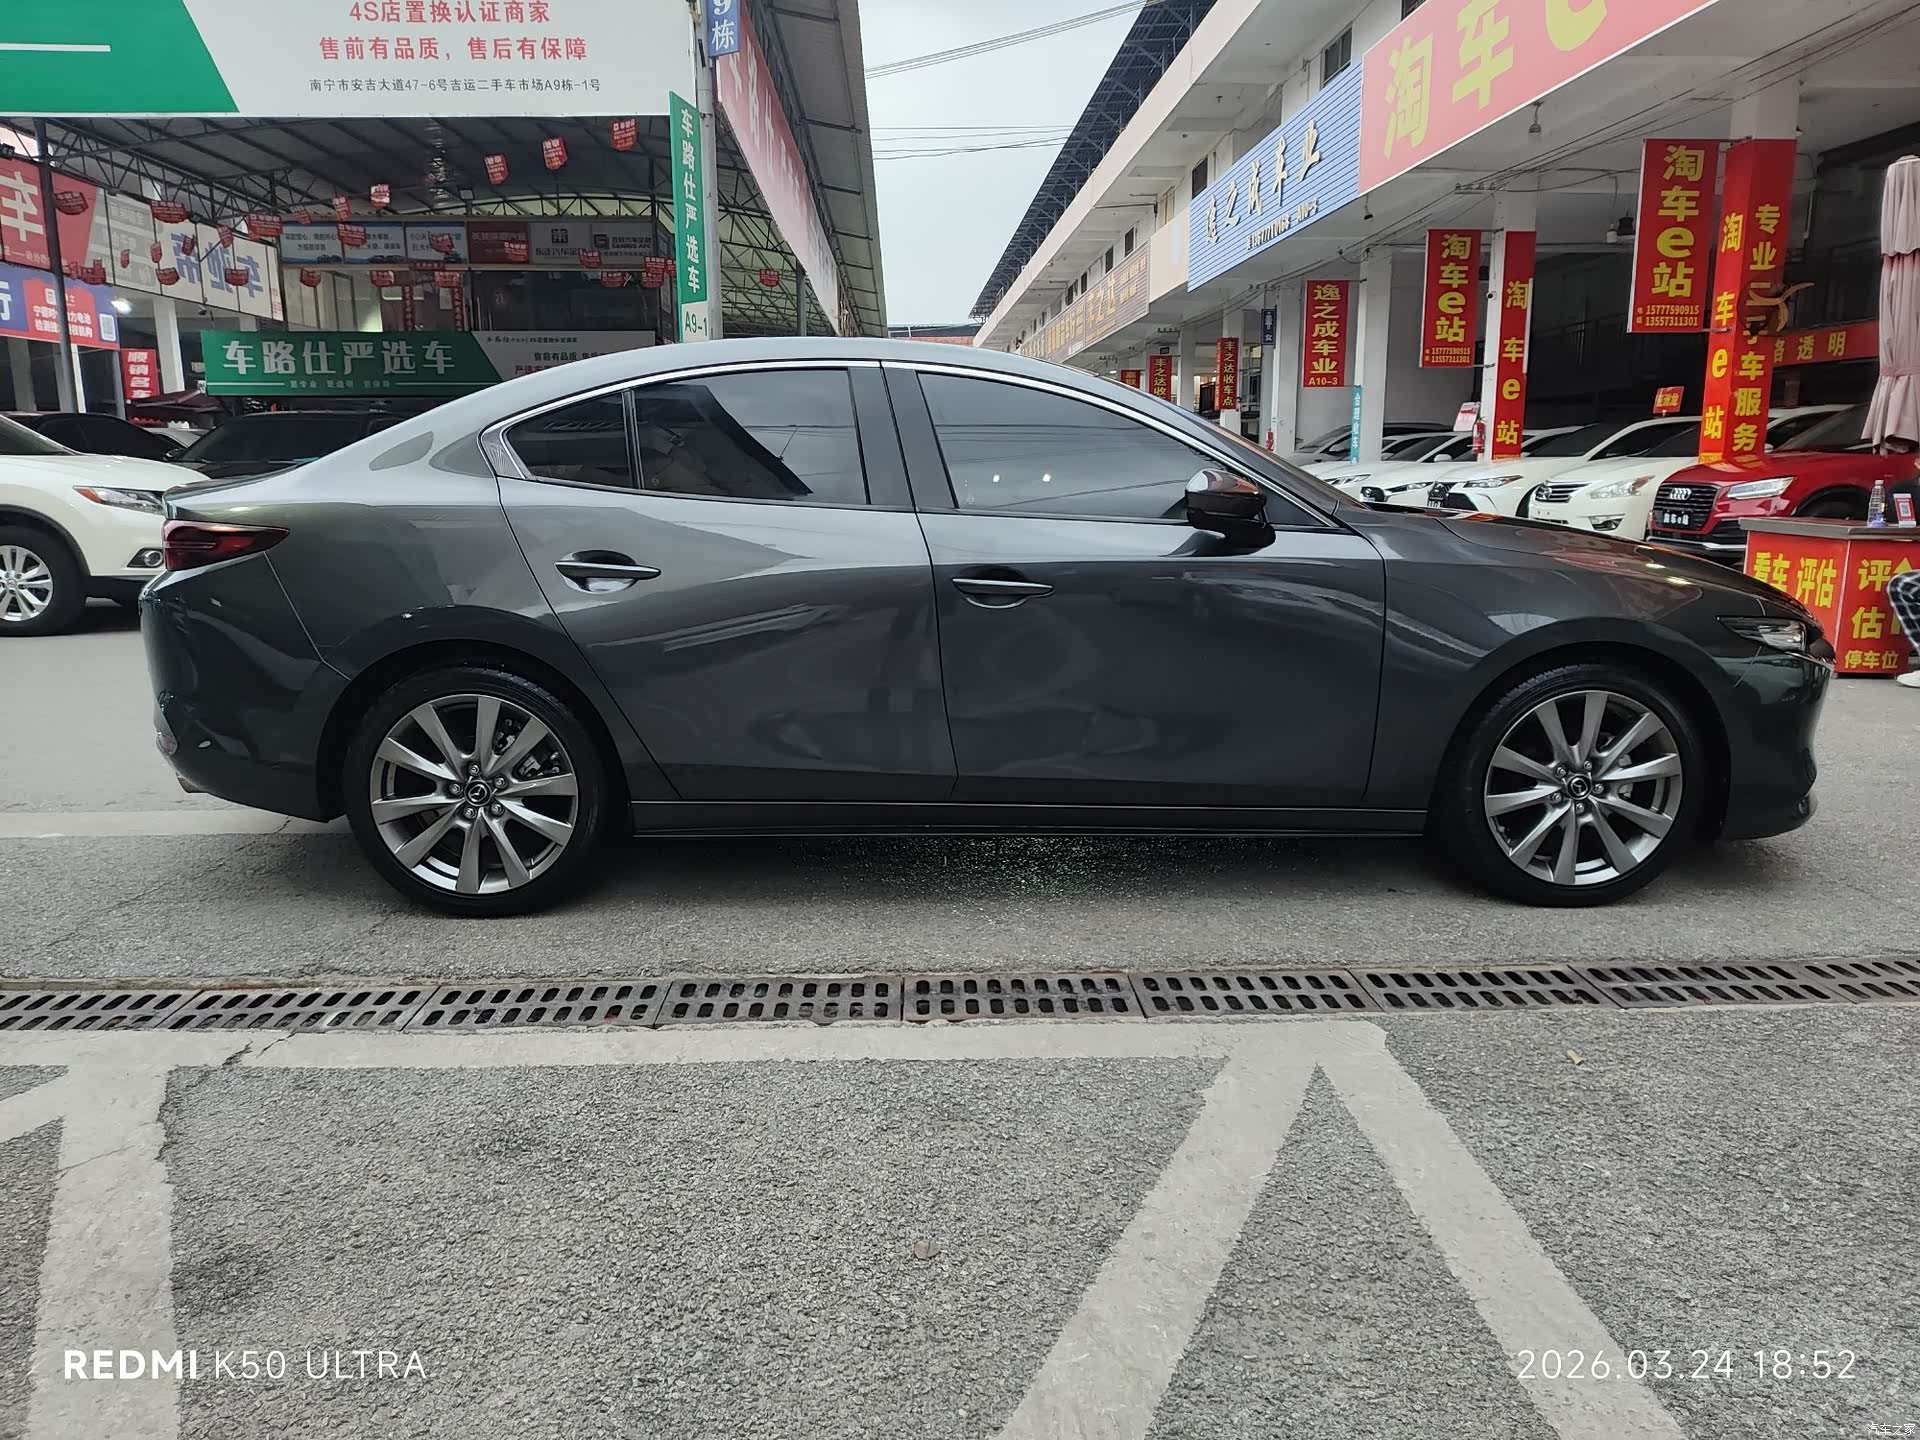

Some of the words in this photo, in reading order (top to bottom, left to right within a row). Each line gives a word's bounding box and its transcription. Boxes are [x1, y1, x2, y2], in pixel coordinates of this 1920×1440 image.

[349, 0, 551, 23] 4S店置换认证商家
[319, 36, 588, 60] 售前有品质，售后有保障
[309, 78, 601, 92] 南宁市安吉大道47-6号吉运二手车市场A9栋-1号
[681, 108, 701, 293] 车路仕严选车
[1651, 144, 1705, 298] 淘车e站
[1434, 233, 1473, 343] 淘车e站
[685, 311, 709, 336] A9-1
[1310, 284, 1341, 374] 逸之成车业
[1644, 315, 1699, 328] 13557311301
[1645, 303, 1700, 316] 15777590915
[1703, 212, 1744, 440] 淘车e站
[222, 340, 455, 375] 车路仕严选车
[1222, 341, 1236, 406] 丰之达收车点
[1495, 280, 1530, 445] 淘车e站
[1153, 358, 1167, 401] 丰之达收
[1308, 376, 1339, 386] A10-3
[1796, 557, 1837, 608] 评估
[1844, 649, 1900, 670] 停车位
